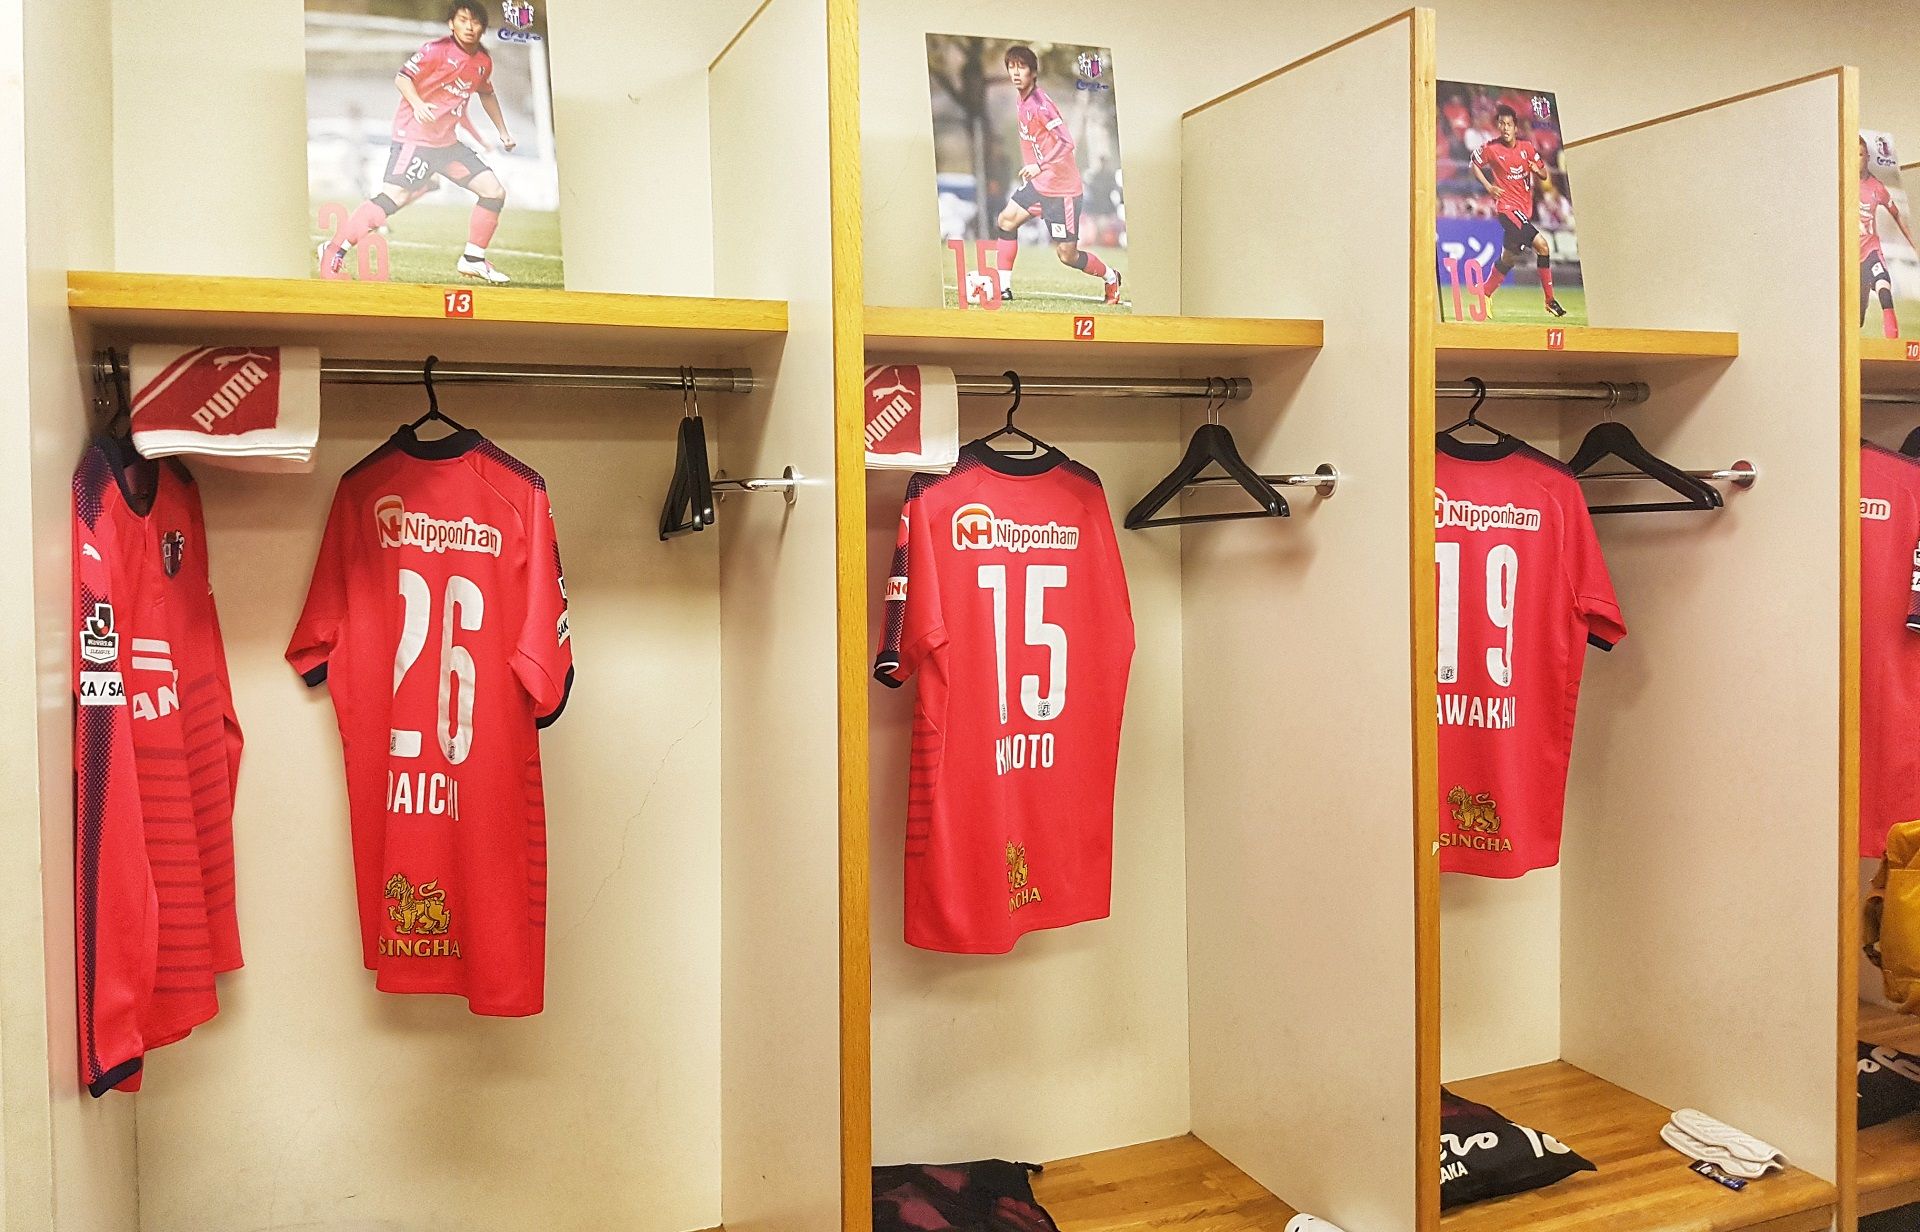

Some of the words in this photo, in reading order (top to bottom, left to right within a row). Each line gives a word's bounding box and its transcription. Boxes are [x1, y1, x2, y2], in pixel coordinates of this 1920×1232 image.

[406, 157, 429, 180] 26
[947, 239, 1002, 311] 15
[1443, 257, 1487, 322] 19
[446, 293, 471, 313] 13
[1075, 320, 1093, 336] 12
[1550, 332, 1562, 346] 11
[1907, 344, 1919, 357] 10
[191, 361, 269, 433] PUMA
[1449, 504, 1539, 528] Nipponham
[956, 520, 992, 545] NH
[996, 523, 1078, 548] Nipponham
[1435, 542, 1519, 687] 19
[977, 564, 1068, 725] 15
[389, 568, 485, 766] 26
[1439, 833, 1513, 853] SINGHA
[378, 935, 462, 959] SINGHA
[1440, 1160, 1469, 1185] AKA
